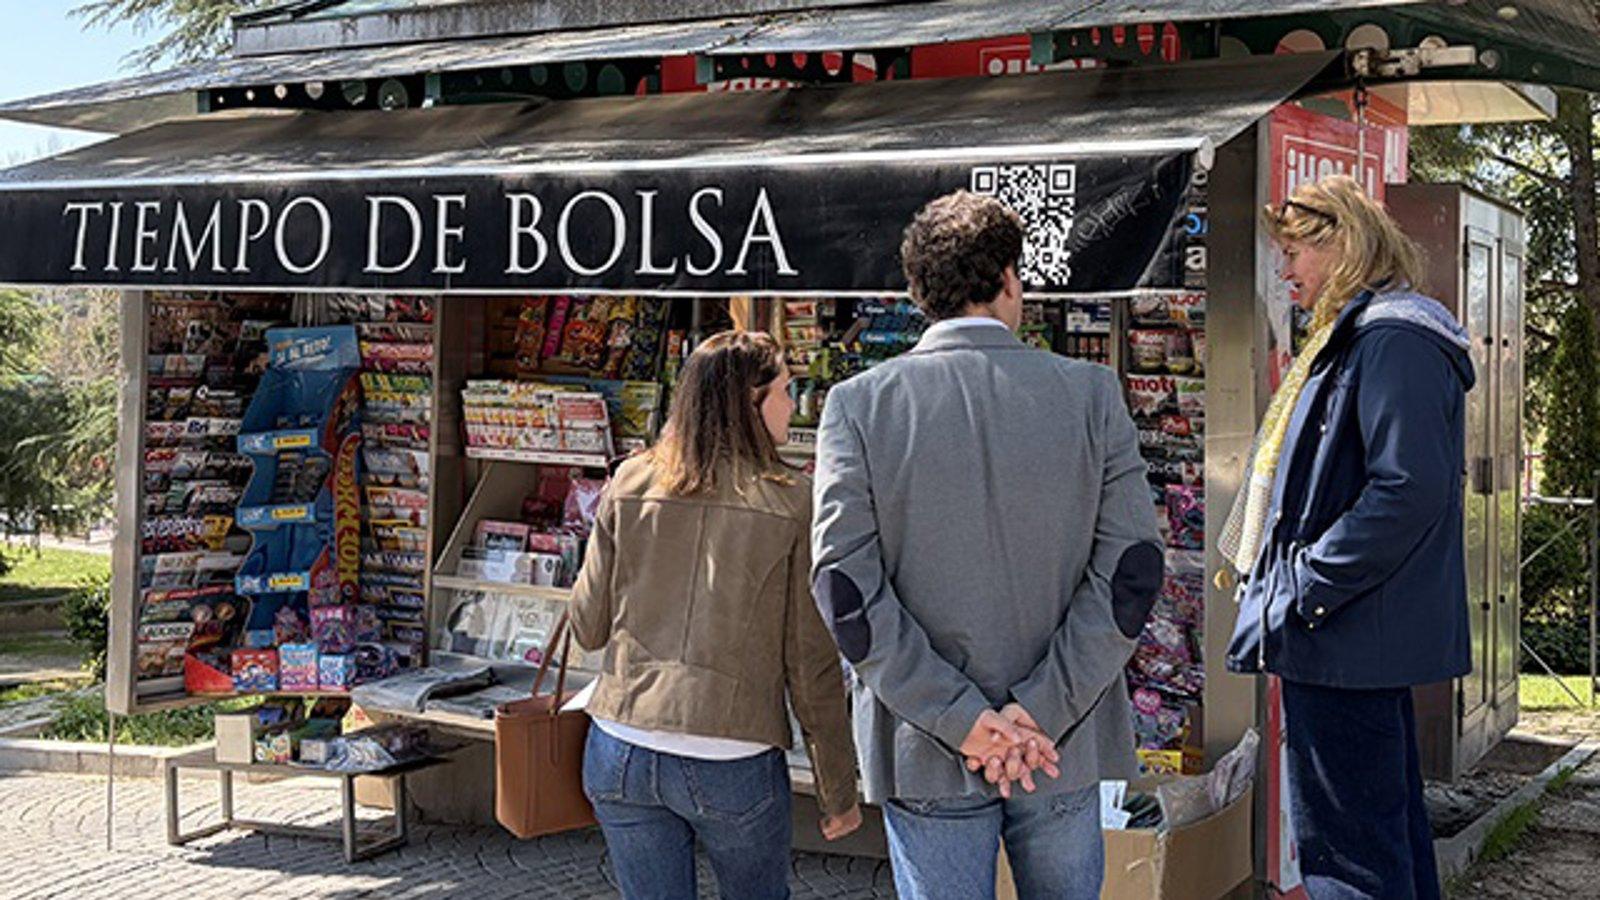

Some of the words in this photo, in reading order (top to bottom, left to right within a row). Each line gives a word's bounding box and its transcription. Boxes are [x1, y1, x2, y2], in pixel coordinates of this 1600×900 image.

[62, 196, 332, 273] TIEMPO
[363, 192, 467, 275] DE
[504, 187, 799, 276] BOLSA
